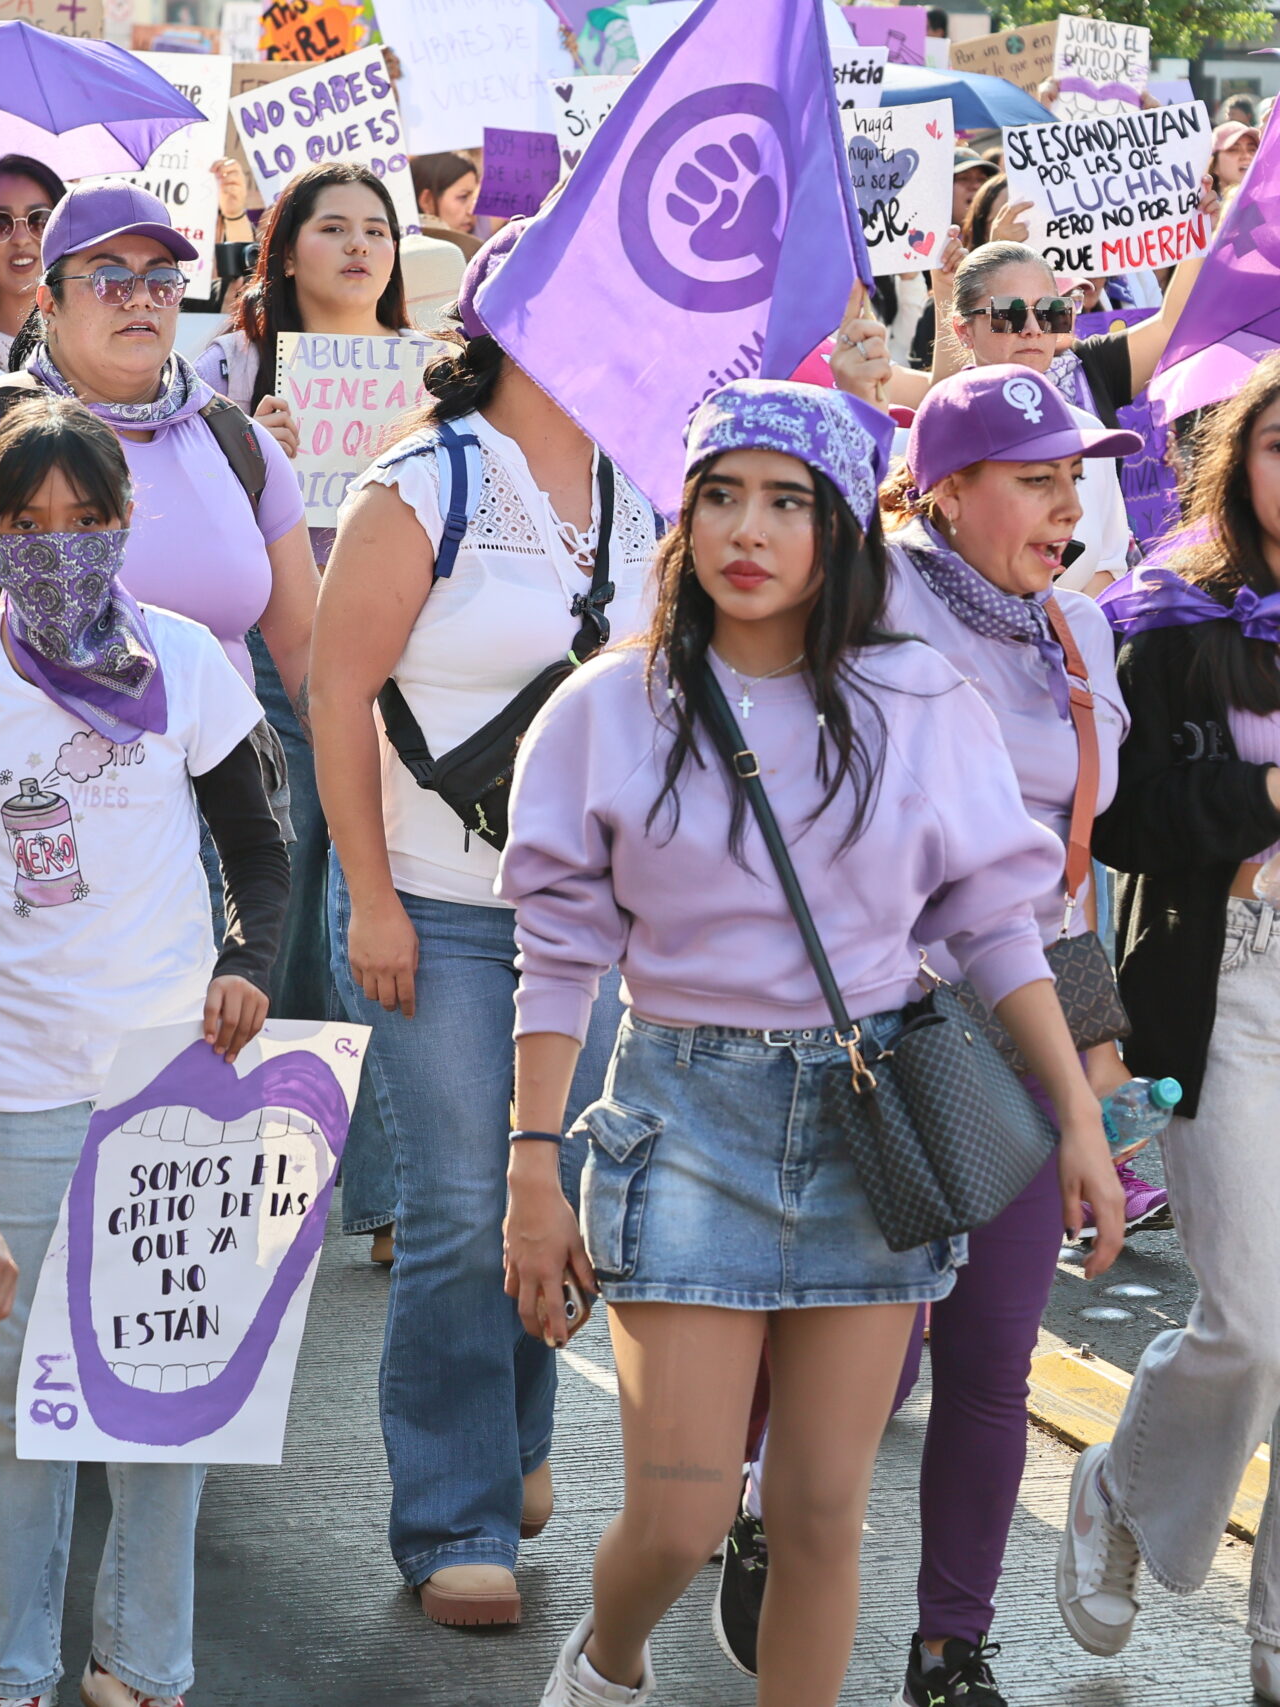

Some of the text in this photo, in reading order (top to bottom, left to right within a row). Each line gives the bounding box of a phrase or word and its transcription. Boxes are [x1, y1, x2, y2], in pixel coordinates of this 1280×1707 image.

[1032, 34, 1051, 48] en
[1065, 17, 1142, 53] SOMOS EL
[1064, 43, 1138, 78] GRITO DE
[240, 62, 391, 138] NO SABES
[254, 110, 400, 179] LO QUE ES
[1007, 106, 1201, 170] SE ESCANDALIZAN
[1037, 146, 1162, 186] POR LAS QUE
[1046, 161, 1197, 217] LUCHAN
[1046, 213, 1094, 239] PERO
[1102, 205, 1134, 230] NO
[1138, 197, 1173, 222] POR
[1042, 213, 1207, 272] QUE MUEREN
[287, 376, 379, 411] VINE
[70, 784, 129, 809] VIBES
[14, 833, 75, 875] AERO
[130, 1154, 291, 1197] SOMOS EL
[108, 1194, 195, 1235] GRITO
[221, 1192, 254, 1218] DE
[132, 1227, 237, 1266] QUE YA
[162, 1264, 206, 1295] NO
[113, 1299, 219, 1349] ESTÁN
[30, 1352, 78, 1430] 8M
